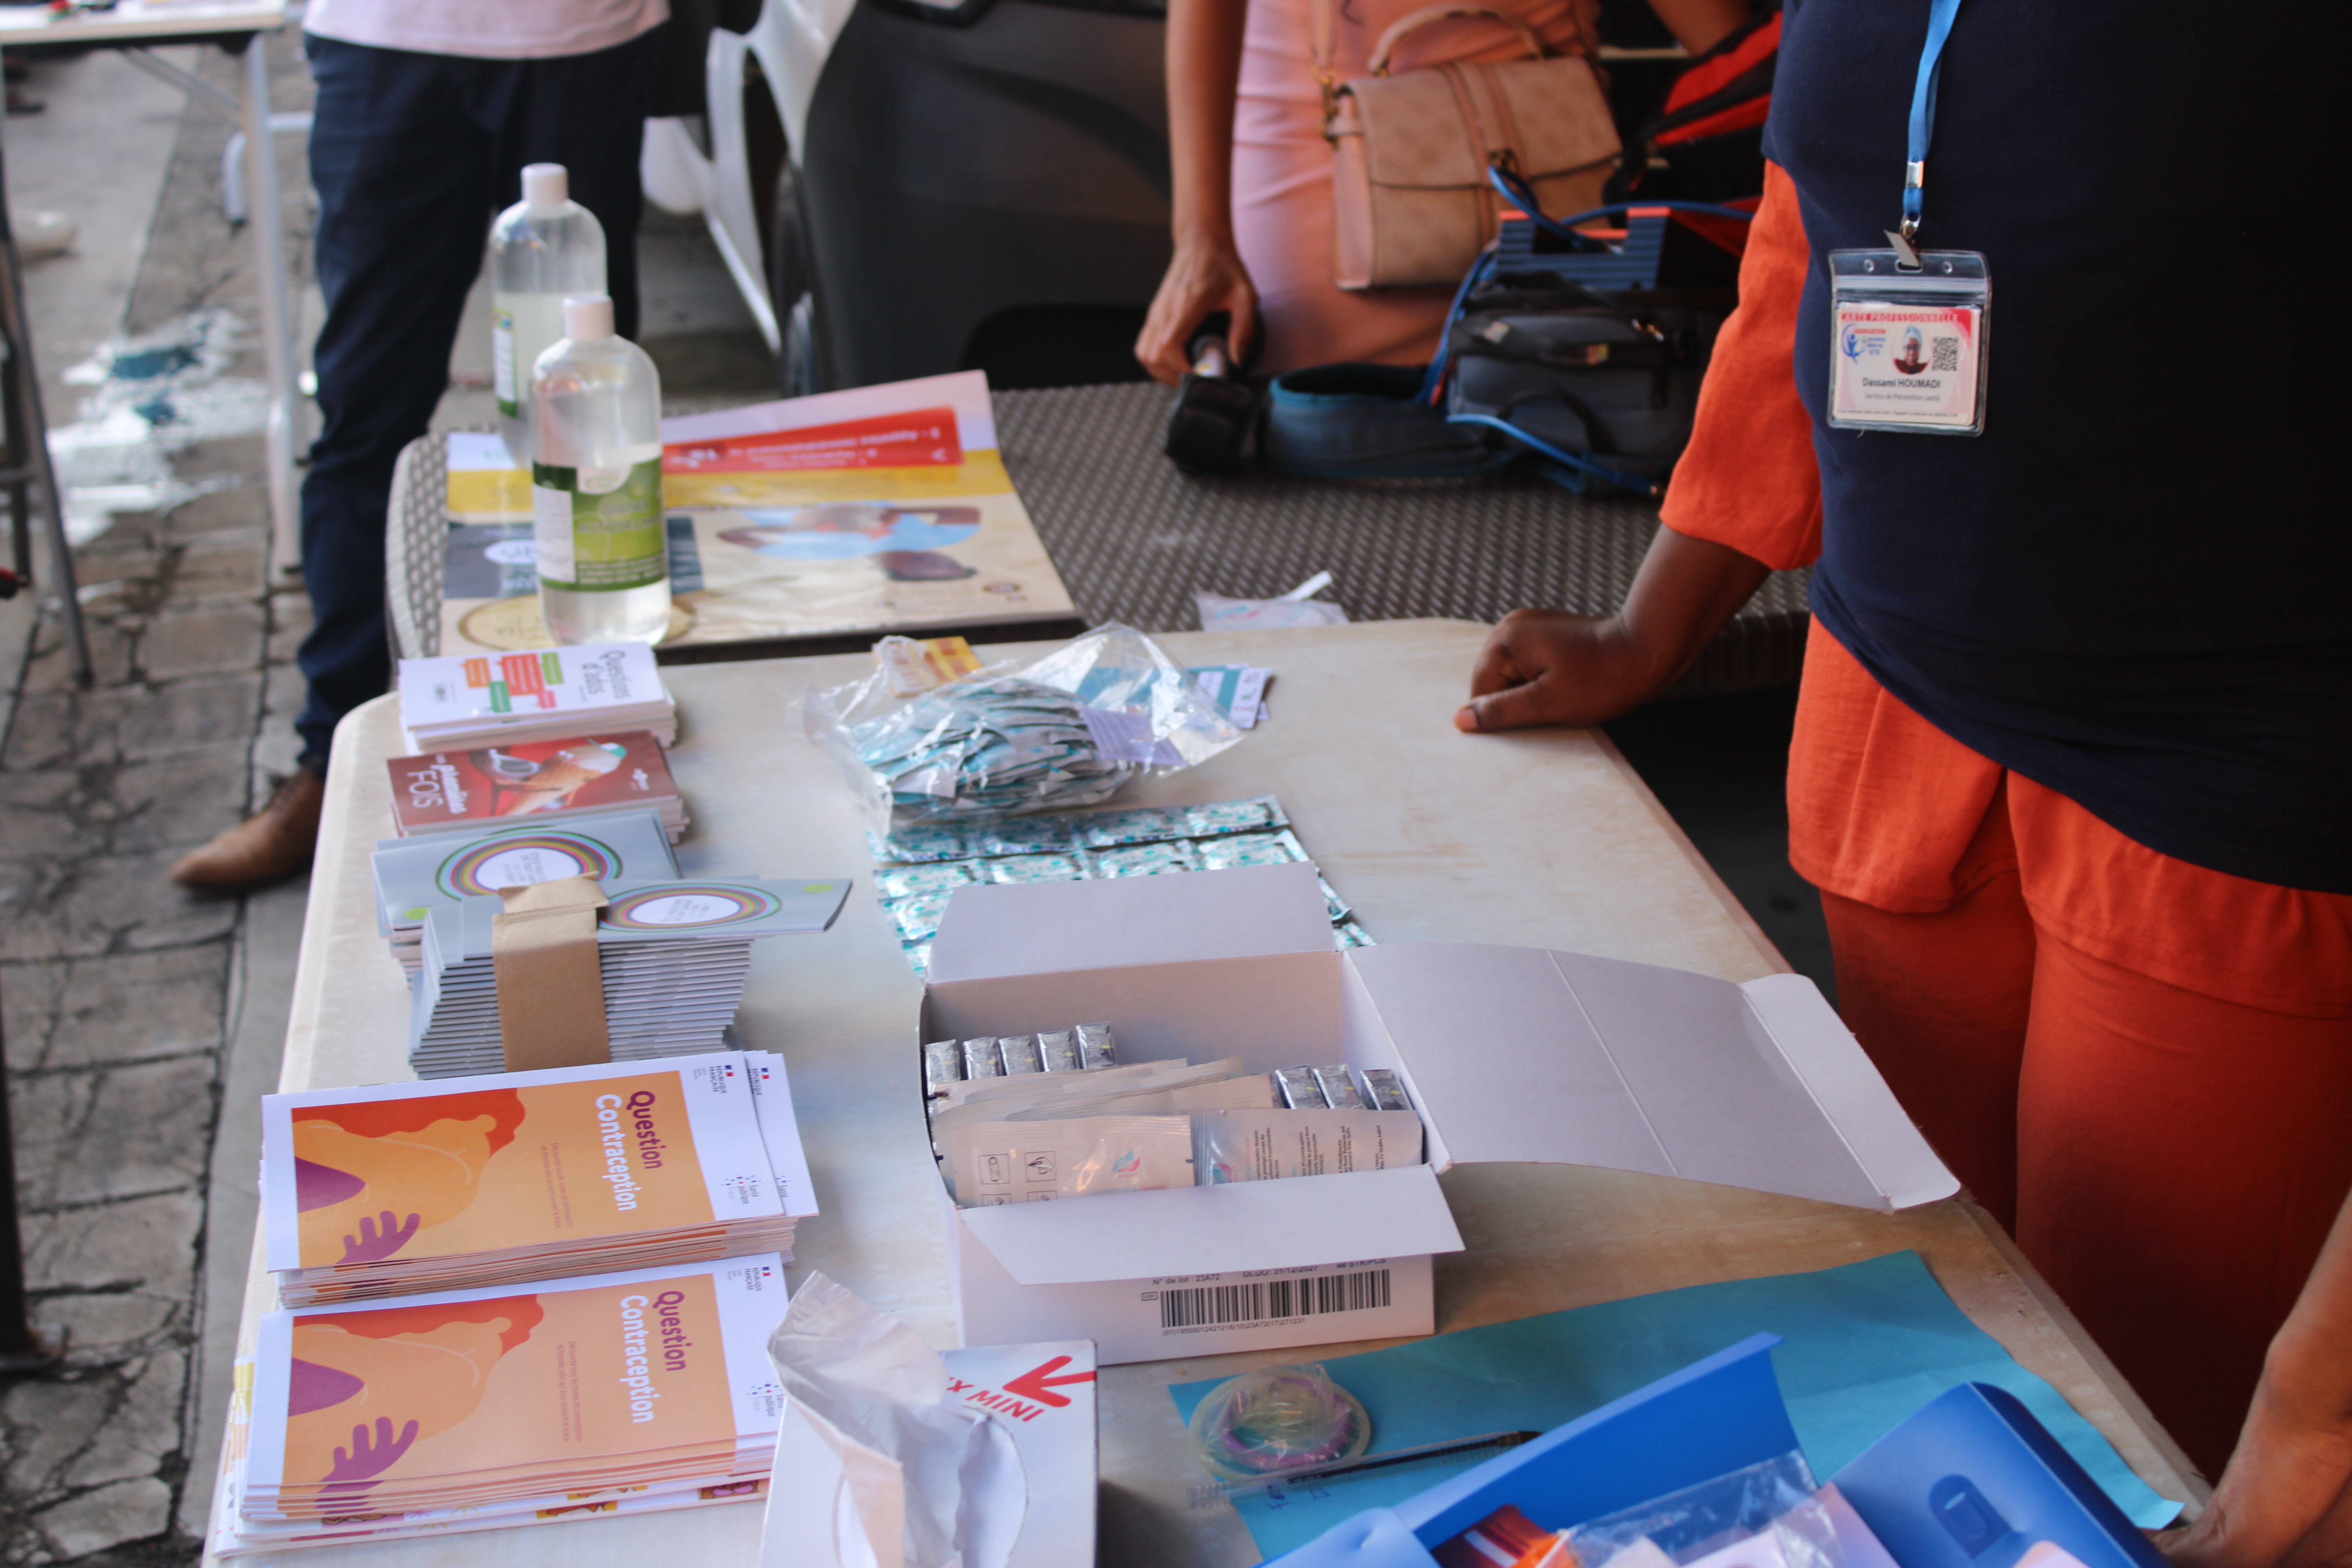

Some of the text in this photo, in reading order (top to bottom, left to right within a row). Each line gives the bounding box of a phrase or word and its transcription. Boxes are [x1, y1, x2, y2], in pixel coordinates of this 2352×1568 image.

[1871, 313, 1958, 322] PROFESSIONNELLE
[1863, 378, 1940, 388] Dassami HOUMADI
[599, 651, 632, 699] Questions
[406, 770, 444, 808] FOIS
[709, 1066, 719, 1093] FRANÇAISE
[716, 1065, 727, 1093] RÉPUBLIQUE
[752, 1068, 762, 1095] RÉPUBLIQUE
[626, 1091, 667, 1169] Question
[595, 1094, 642, 1211] Contraception
[736, 1186, 750, 1204] publique
[748, 1184, 762, 1197] Santé
[744, 1268, 755, 1290] FRANÇAISE
[753, 1267, 762, 1291] RÉPUBLIQUE
[1196, 1274, 1221, 1282] 23A72
[652, 1290, 693, 1371] Question
[619, 1295, 661, 1423] Contraception
[762, 1395, 776, 1416] publique
[965, 1390, 1045, 1422] MINI
